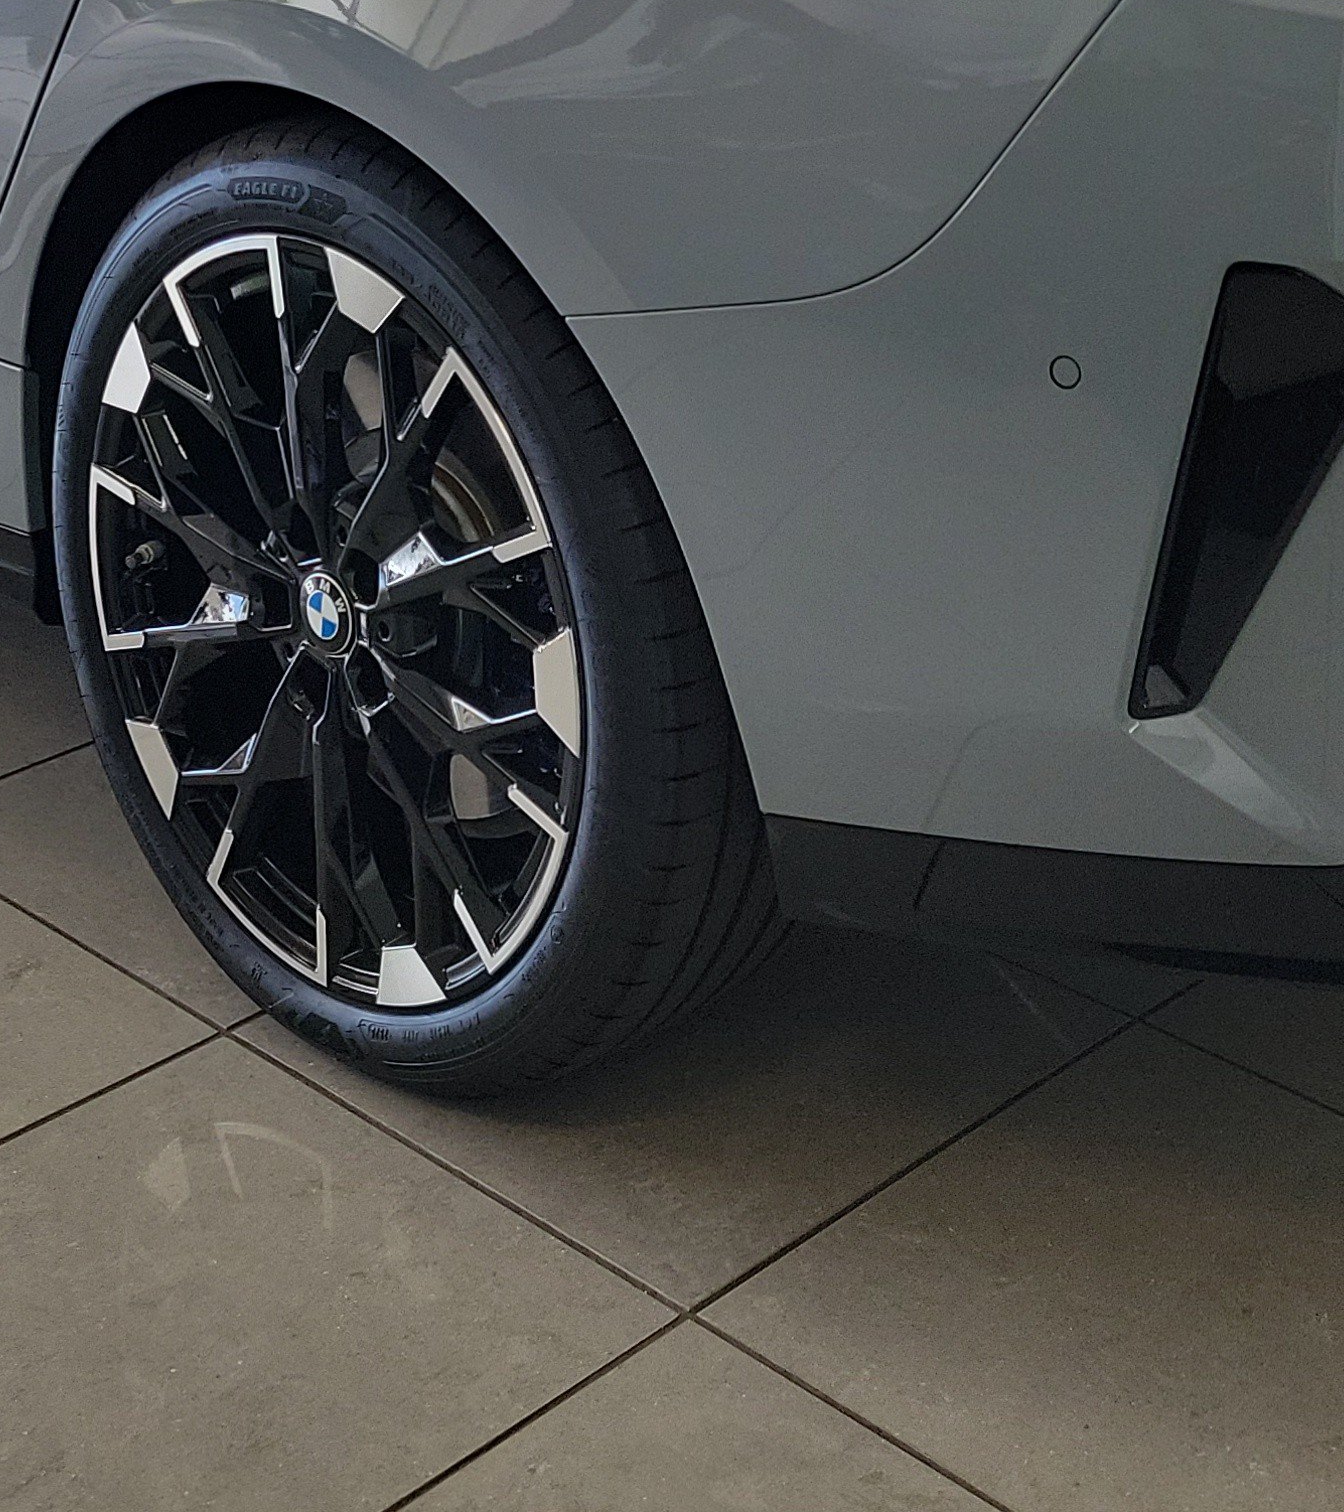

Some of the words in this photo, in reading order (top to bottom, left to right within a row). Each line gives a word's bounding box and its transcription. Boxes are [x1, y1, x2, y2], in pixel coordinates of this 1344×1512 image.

[234, 181, 277, 196] EAGLE
[281, 184, 298, 199] F1
[304, 578, 346, 613] BMW
